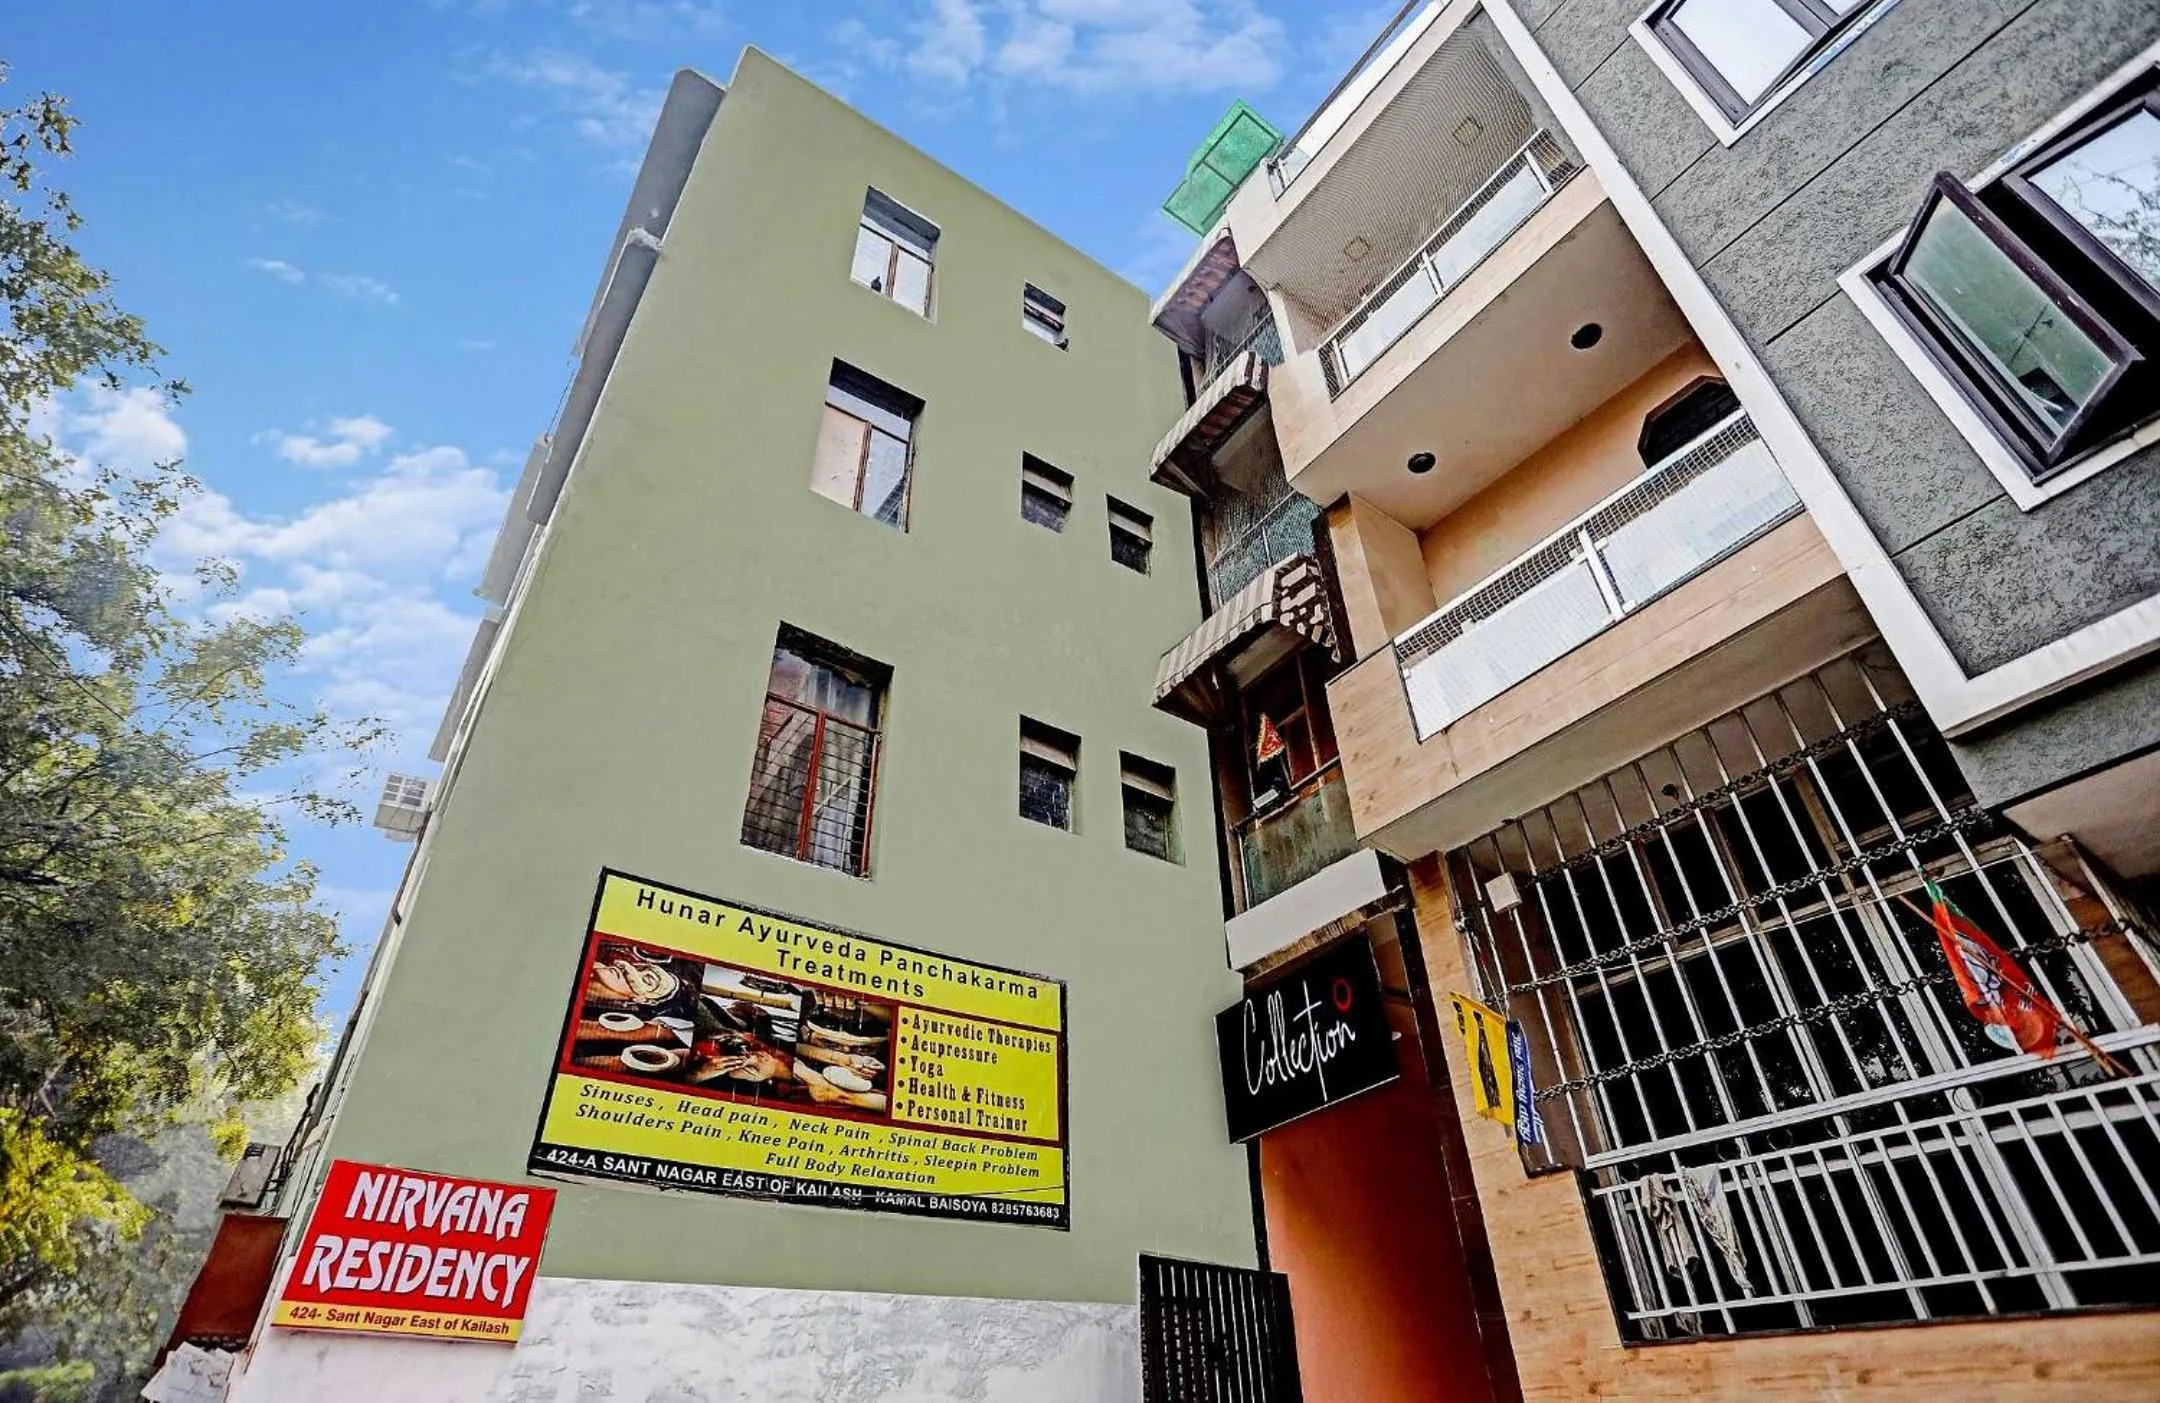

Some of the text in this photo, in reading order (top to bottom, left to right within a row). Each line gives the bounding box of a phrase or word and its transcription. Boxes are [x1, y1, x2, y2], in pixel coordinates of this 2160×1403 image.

[637, 888, 1038, 999] Hunar Ayurveda Panchakarma
[776, 949, 924, 998] Treatments
[910, 1034, 998, 1065] Acupressure
[912, 1013, 1052, 1054] Ayurvedic Therapies
[1243, 980, 1356, 1102] Collection
[910, 1055, 944, 1078] Yoga
[907, 1099, 1028, 1132] Personal Trainer
[908, 1077, 1025, 1111] Health & Fitness
[575, 1103, 675, 1131] Shoulders
[738, 1129, 782, 1147] Knee
[924, 1154, 977, 1172] Sleepin
[982, 1160, 1040, 1178] Problem
[677, 1100, 725, 1119] Head
[789, 1118, 829, 1135] Neck
[888, 1132, 937, 1150] Spinal
[941, 1139, 976, 1155] Back
[980, 1143, 1038, 1161] Problem
[546, 1149, 597, 1169] 424-A
[602, 1155, 652, 1176] SANT
[656, 1164, 717, 1186] NAGAR
[722, 1172, 765, 1191] EAST
[770, 1179, 791, 1194] OF
[875, 1190, 926, 1208] KAMAL
[929, 1197, 987, 1214] BAISOYA
[991, 1202, 1060, 1219] 8285763683
[765, 1152, 936, 1185] Full Body Relaxation
[345, 1171, 529, 1242] NIRVANA
[301, 1234, 531, 1309] RESIDENCY
[289, 1305, 510, 1335] 424- Sant Nagar East of Kailash
